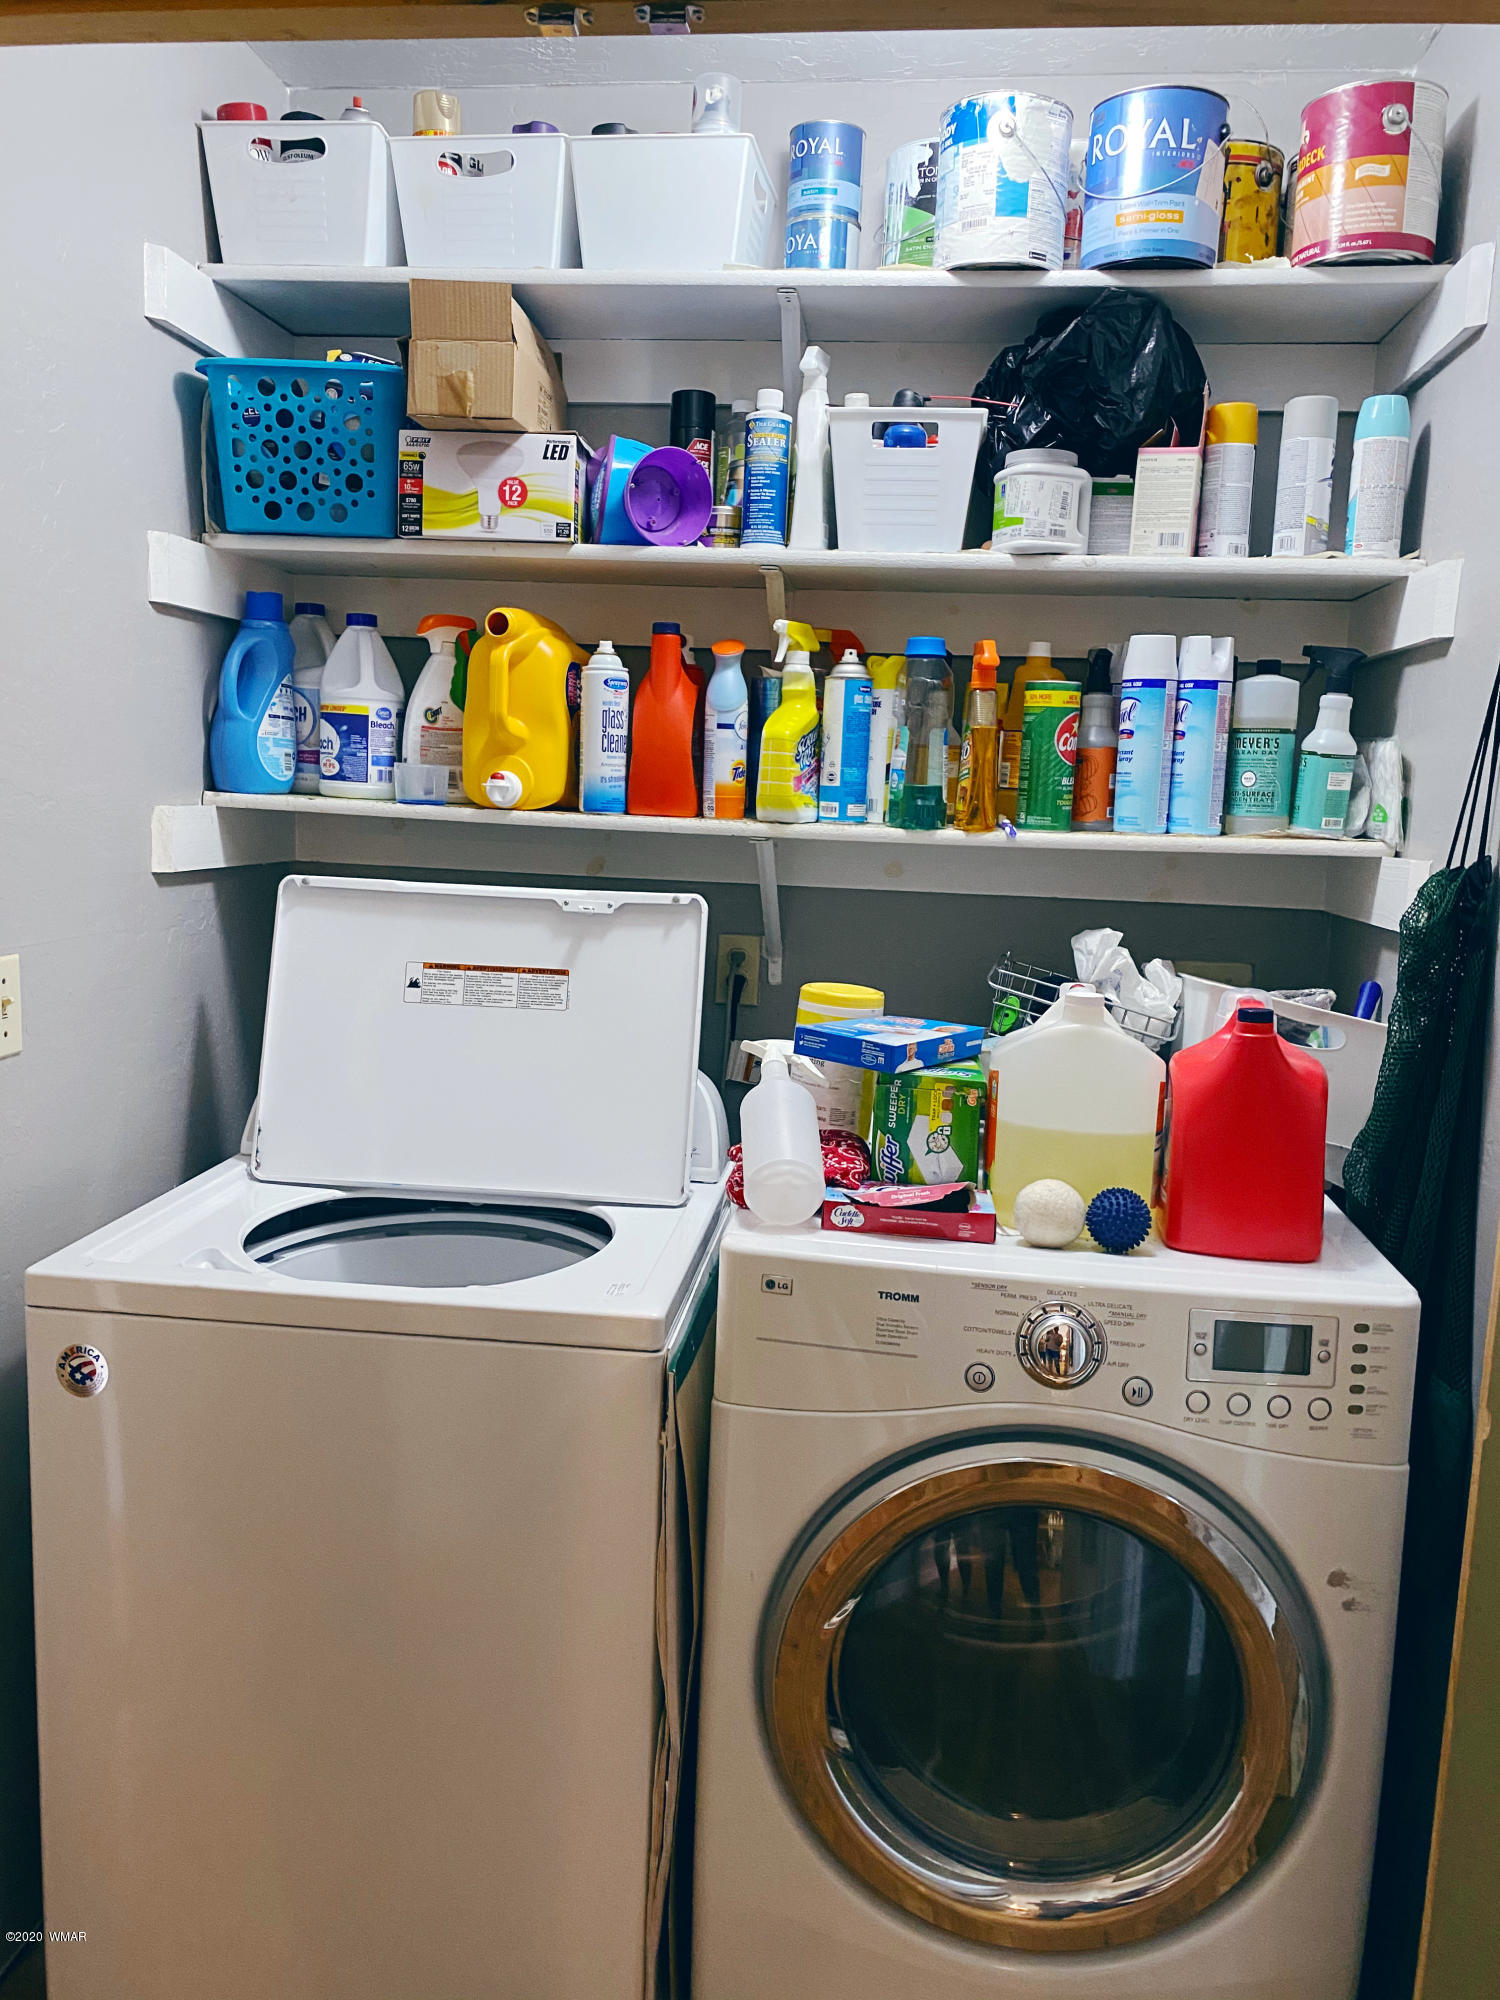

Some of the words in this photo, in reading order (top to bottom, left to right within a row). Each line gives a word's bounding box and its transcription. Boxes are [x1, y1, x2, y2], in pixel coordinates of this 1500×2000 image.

[790, 137, 844, 161] ROYAL
[1152, 151, 1195, 159] INTERIORS
[1119, 211, 1181, 224] semi-gloss
[785, 232, 818, 254] OYA
[694, 441, 709, 451] ACE
[747, 433, 787, 448] SEALER
[542, 444, 570, 461] LED
[502, 484, 522, 501] 12
[402, 525, 409, 533] 12
[370, 720, 395, 730] Bleach
[602, 707, 624, 734] glass
[1234, 737, 1280, 749] MEYER'S
[888, 1079, 902, 1128] SWEEPER
[897, 1093, 906, 1115] DRY
[777, 1281, 789, 1290] LG
[878, 1290, 920, 1303] TROMM
[1046, 1288, 1077, 1297] DELICATES
[994, 1309, 1019, 1317] NORMAL
[1110, 1340, 1136, 1348] FRESHEN
[58, 1346, 100, 1370] AMERICA
